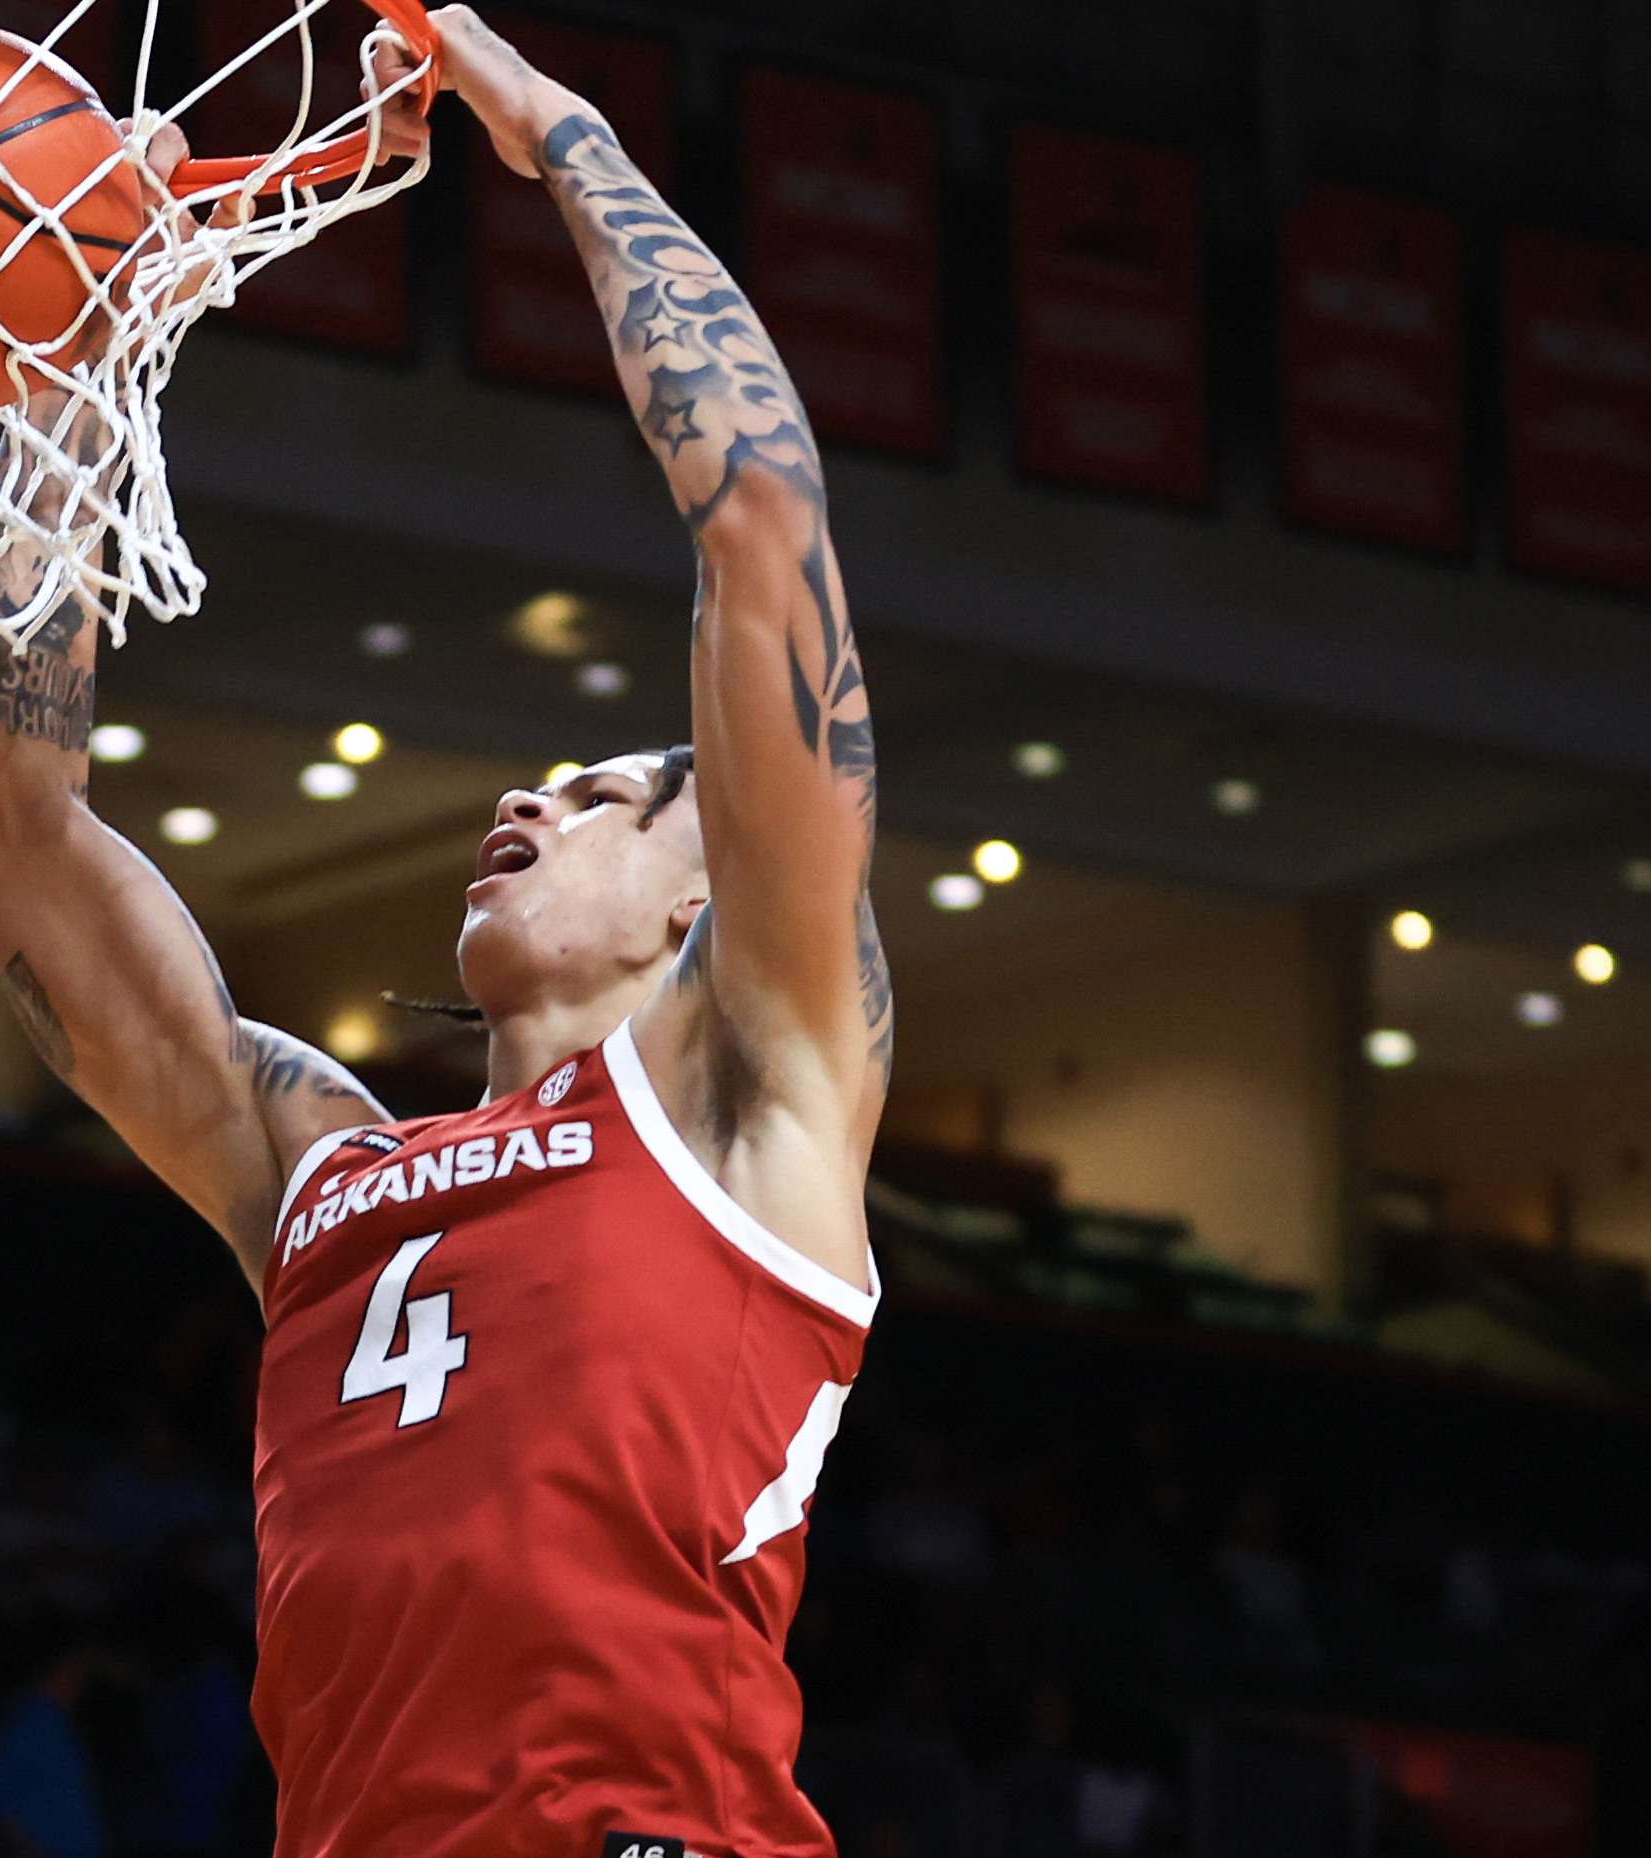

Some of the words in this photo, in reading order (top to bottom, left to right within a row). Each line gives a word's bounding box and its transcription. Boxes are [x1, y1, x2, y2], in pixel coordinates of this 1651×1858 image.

[540, 1064, 576, 1103] SEC
[282, 1121, 593, 1268] ARKANSAS
[340, 1231, 469, 1428] 4
